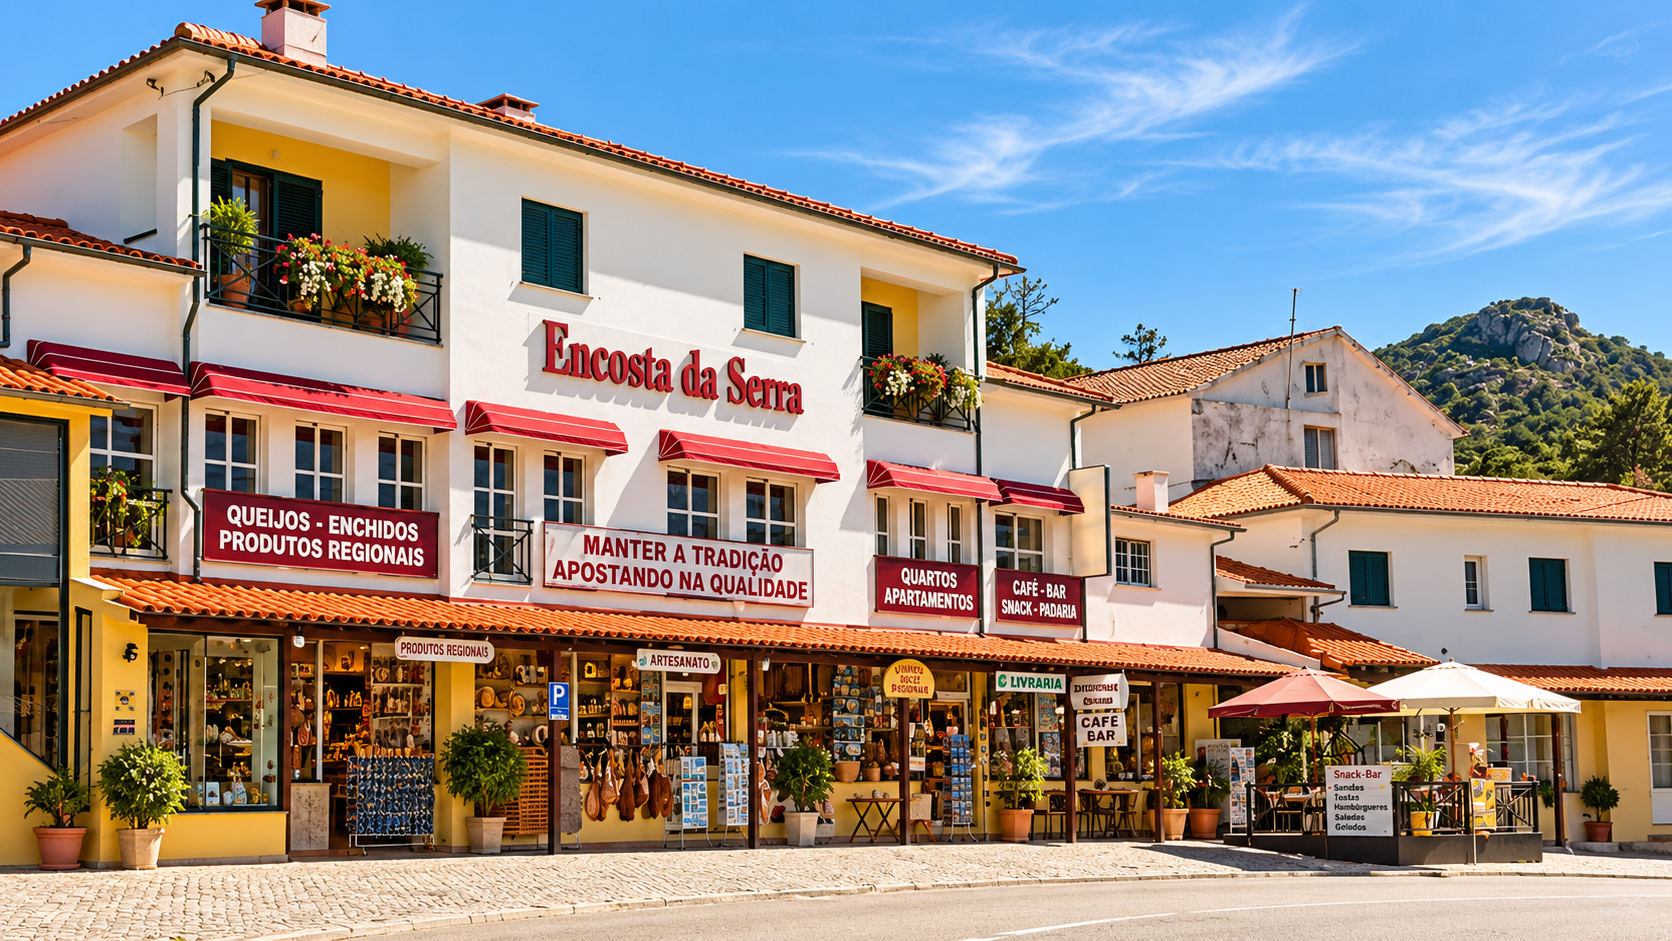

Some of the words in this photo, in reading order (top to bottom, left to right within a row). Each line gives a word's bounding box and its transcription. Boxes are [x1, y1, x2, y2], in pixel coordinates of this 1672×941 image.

[542, 319, 674, 393] Encosta
[681, 349, 719, 401] da
[727, 356, 804, 415] Serra
[226, 504, 310, 532] QUEIJOS
[328, 515, 419, 542] ENCHIDOS
[219, 529, 323, 558] PRODUTOS
[328, 540, 424, 567] REGIONAIS
[583, 534, 667, 562] MANTER
[673, 544, 687, 564] A
[692, 545, 783, 576] TRADIÇÃO
[552, 559, 674, 589] APOSTANDO
[679, 571, 705, 592] NA
[709, 573, 808, 600] QUALIDADE
[900, 567, 958, 589] QUARTOS
[884, 587, 974, 611] APARTAMENTOS
[1012, 578, 1039, 597] CAFÉ
[1046, 583, 1066, 600] BAR
[1001, 599, 1033, 617] SNACK
[1039, 602, 1077, 619] PADARIA
[400, 641, 445, 656] PRODUTOS
[446, 644, 489, 658] REGIONAIS
[650, 654, 710, 669] ARTESANATO
[1010, 676, 1062, 690] LIVRARIA
[553, 685, 565, 705] P
[1081, 715, 1119, 728] CAFE
[1087, 730, 1116, 742] BAR
[1333, 769, 1382, 779] Snack-Bar
